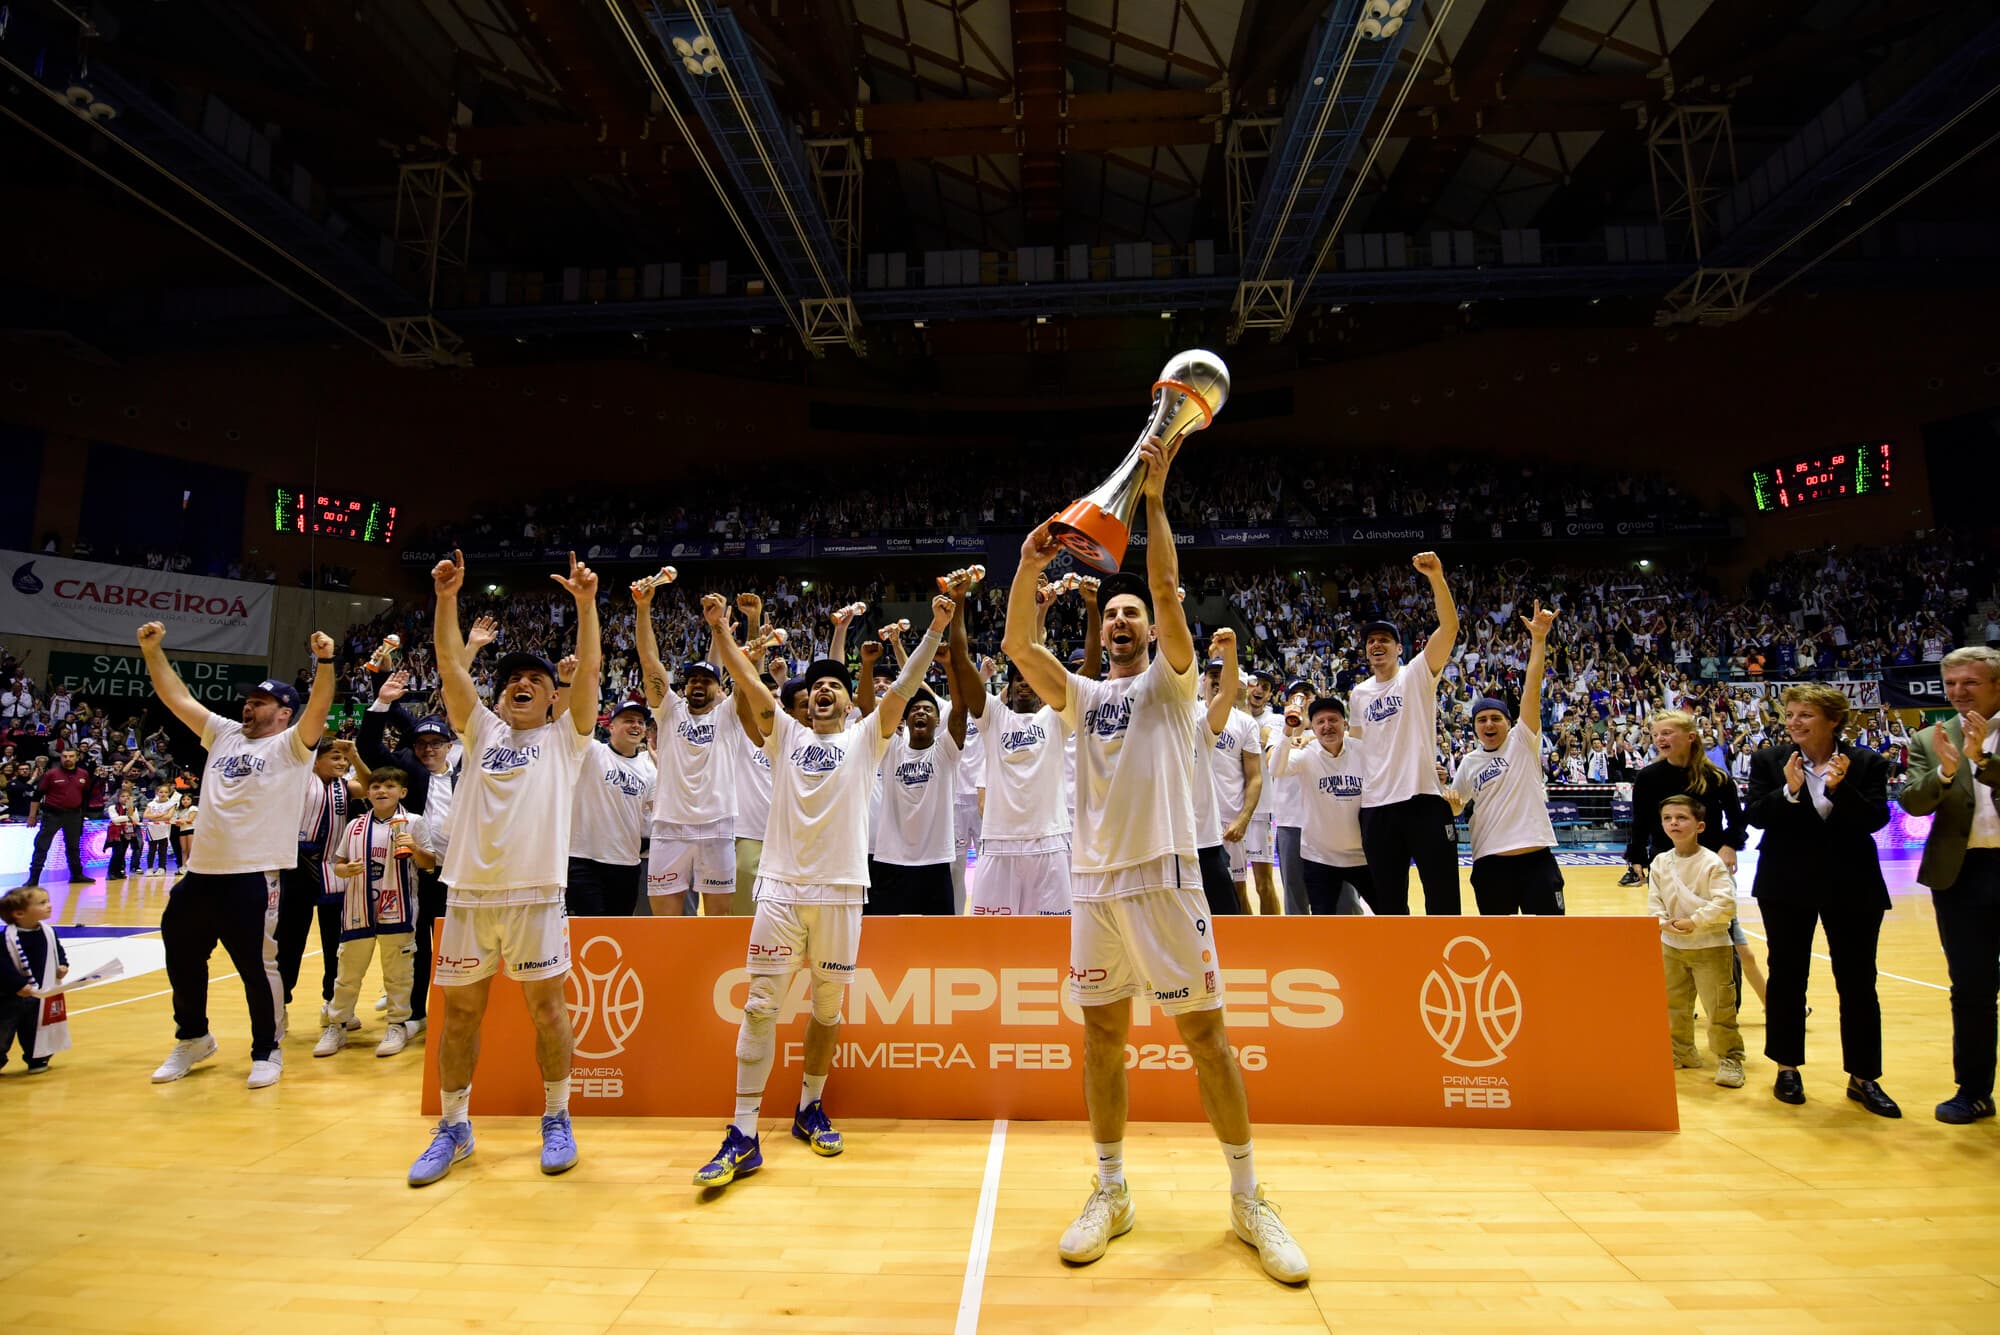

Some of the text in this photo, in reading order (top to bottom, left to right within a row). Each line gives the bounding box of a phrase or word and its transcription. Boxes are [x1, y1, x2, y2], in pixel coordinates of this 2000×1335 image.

[1796, 463, 1808, 472] 85
[1832, 455, 1844, 465] 68
[318, 497, 329, 505] 85
[350, 502, 360, 510] 68
[1366, 530, 1424, 540] dinahosting
[54, 579, 249, 618] CABREIROÁ
[88, 605, 134, 616] MINERAL
[142, 611, 186, 622] NATURAL
[209, 619, 248, 627] GALICIA
[195, 663, 230, 681] DE
[1196, 919, 1206, 936] 9
[750, 944, 792, 956] BYD
[437, 956, 480, 968] BYD
[524, 956, 558, 969] MONBUS
[1154, 988, 1189, 1000] ONBUS
[784, 1042, 976, 1069] PIMERA
[989, 1043, 1072, 1069] FEB
[1442, 1076, 1509, 1086] PRIMERA
[1444, 1088, 1511, 1108] FEB
